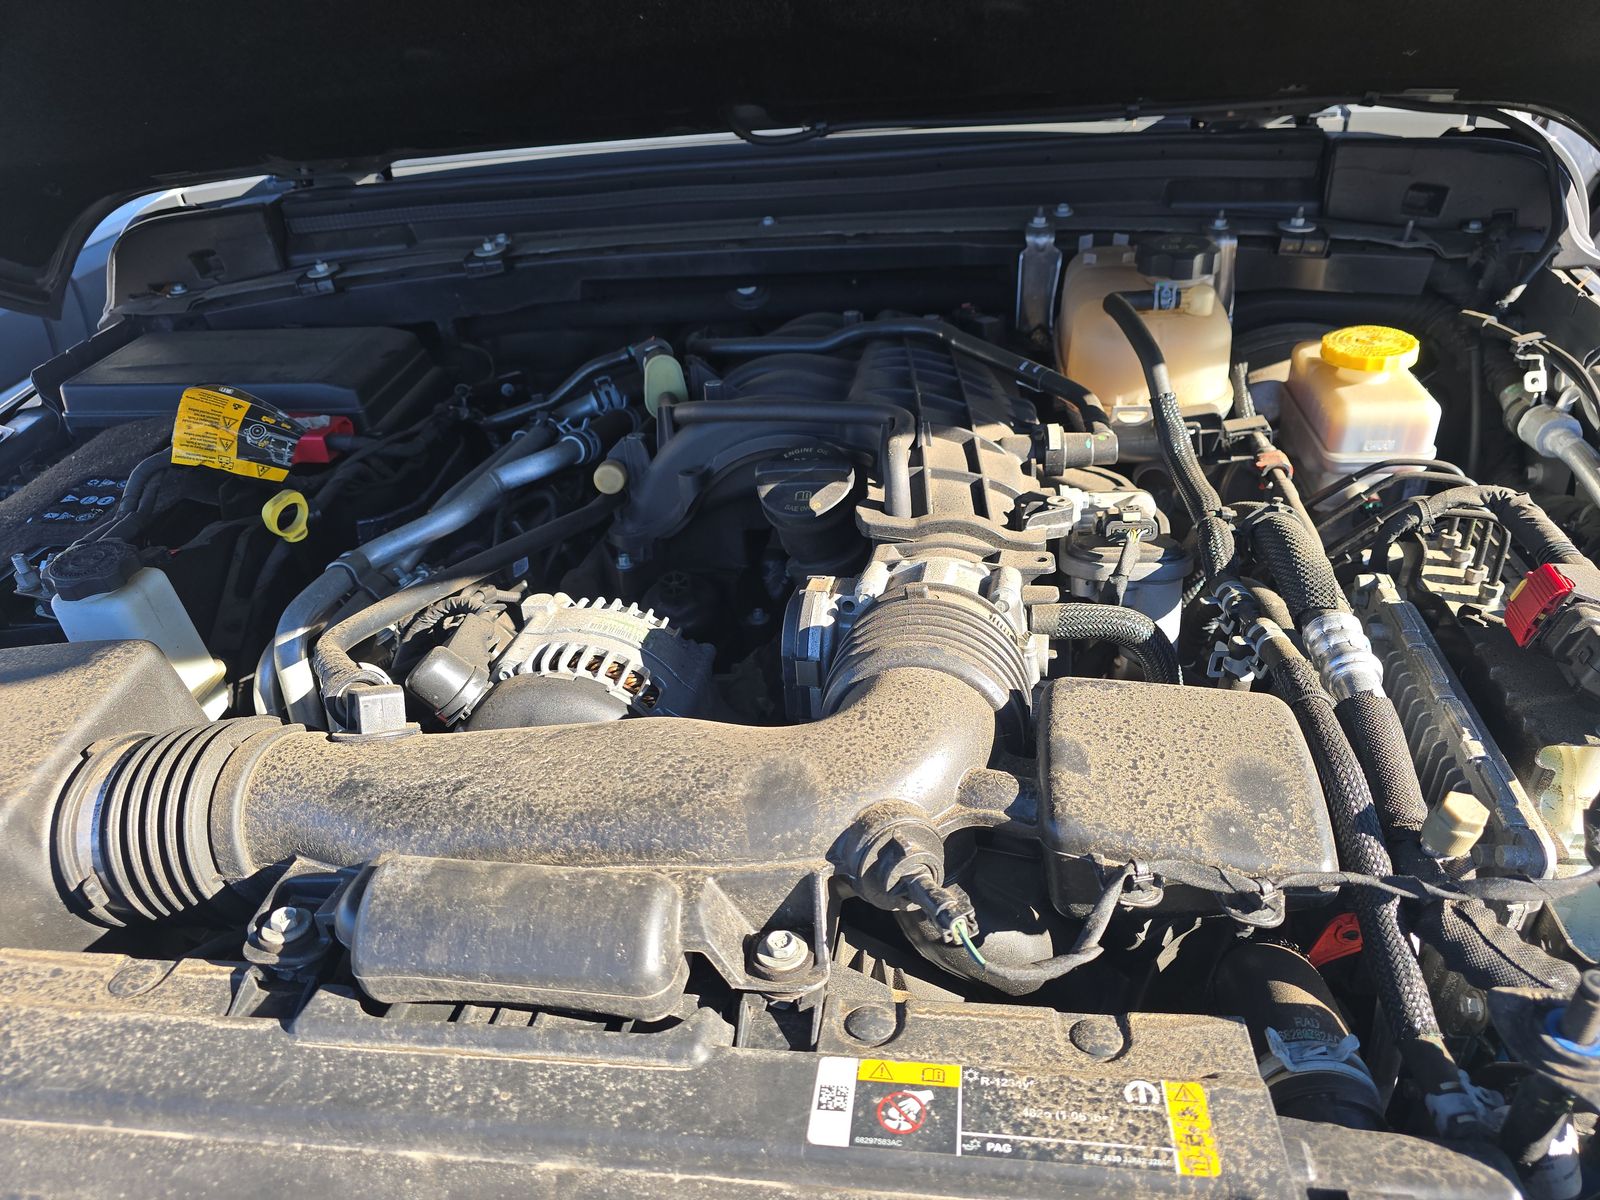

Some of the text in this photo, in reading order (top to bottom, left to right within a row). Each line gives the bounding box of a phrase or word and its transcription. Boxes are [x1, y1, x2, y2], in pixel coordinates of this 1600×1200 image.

[783, 447, 813, 458] ENGINE
[1294, 1017, 1319, 1030] RAD
[986, 1142, 1013, 1153] PAG
[1082, 1152, 1100, 1161] SAE
